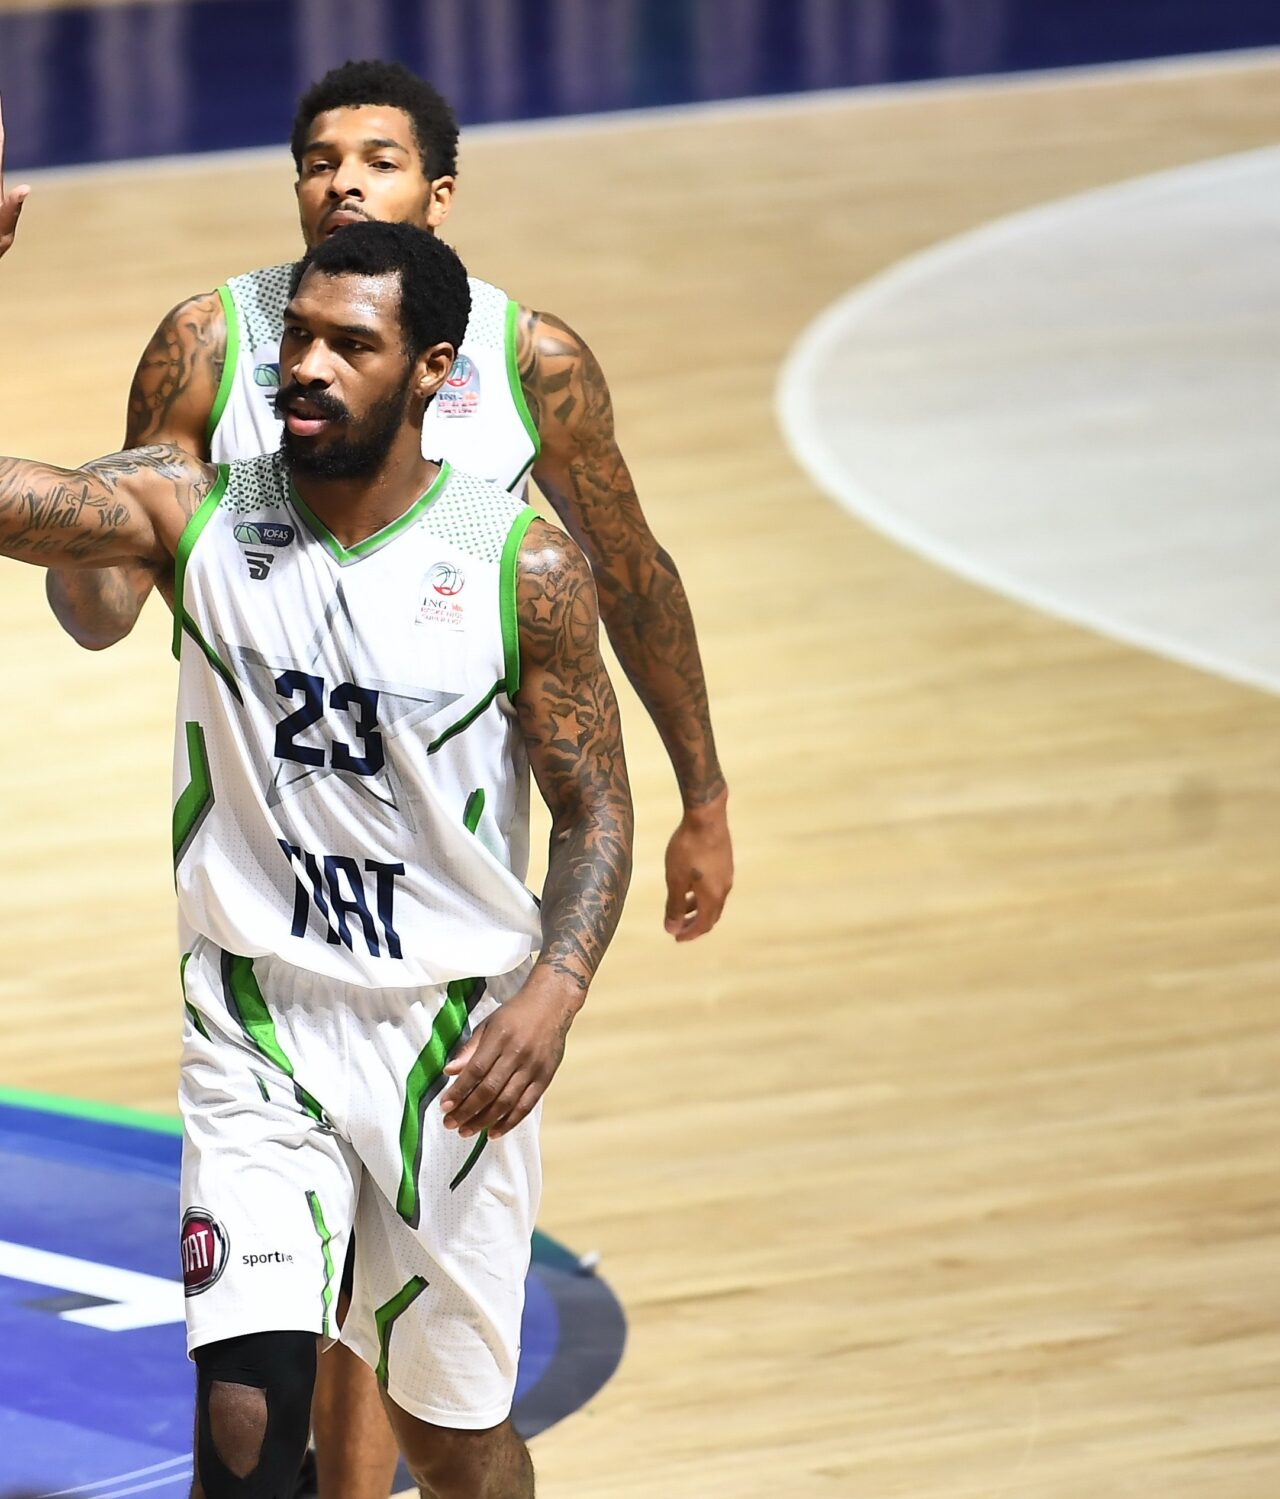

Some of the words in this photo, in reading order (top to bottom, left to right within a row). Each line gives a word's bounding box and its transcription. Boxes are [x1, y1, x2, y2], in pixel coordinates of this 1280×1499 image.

[18, 484, 106, 530] What
[98, 502, 131, 528] we
[274, 669, 384, 776] 23
